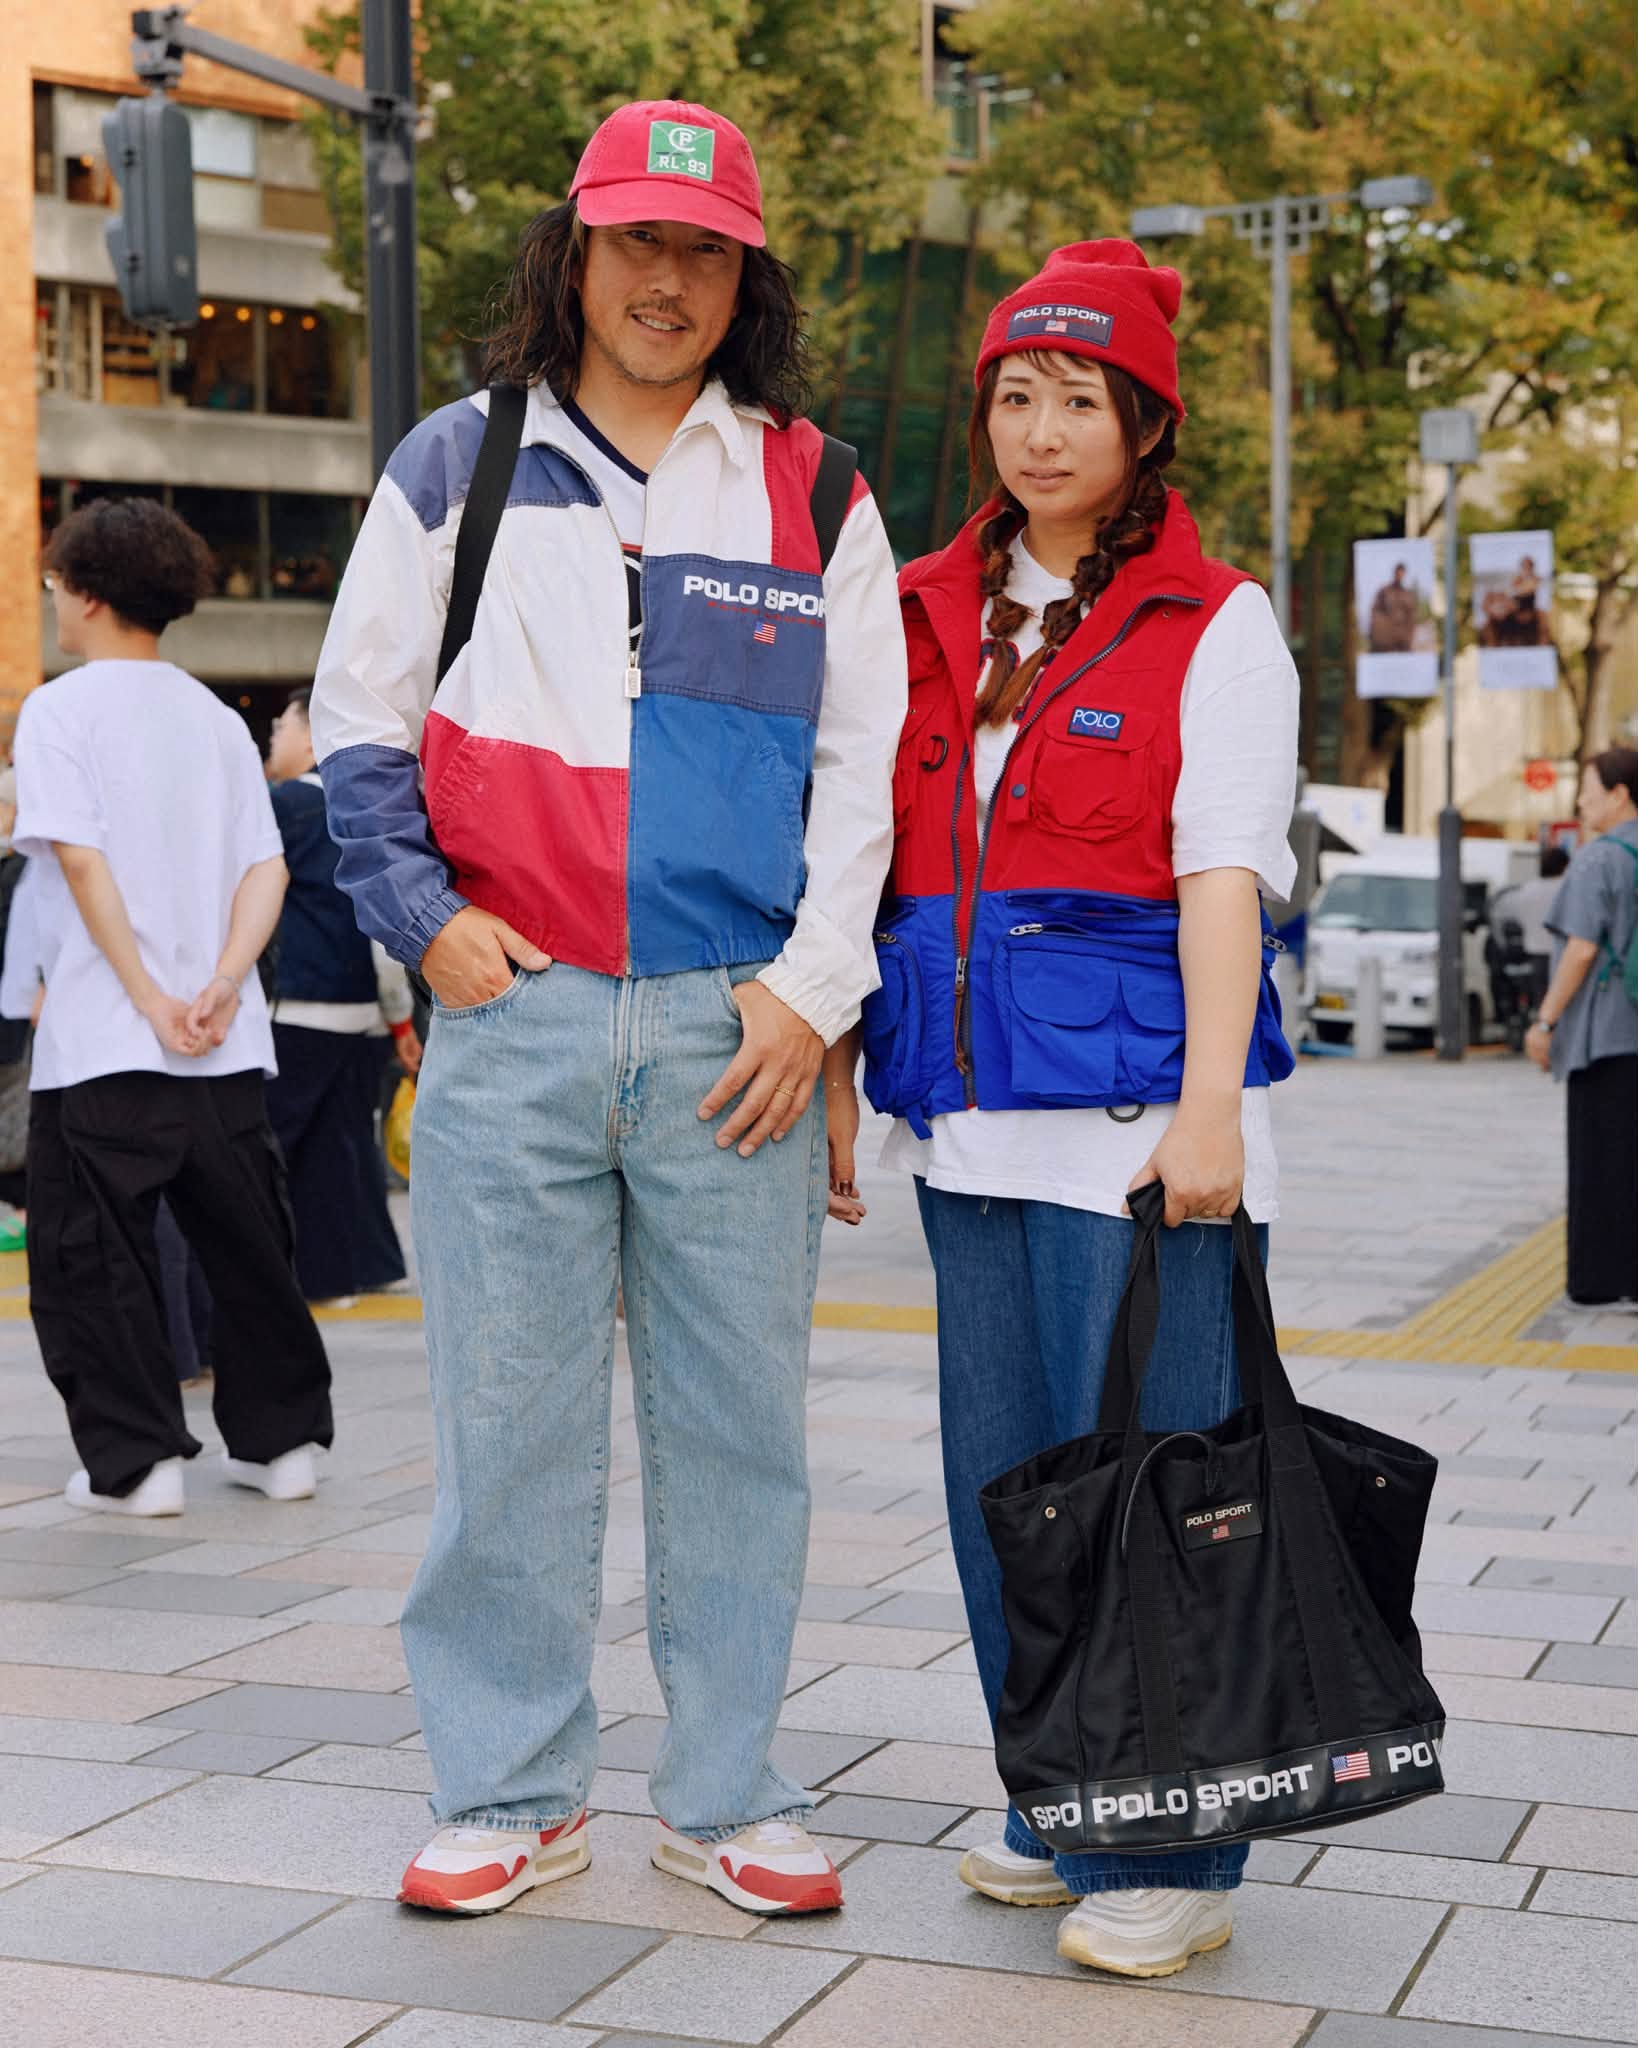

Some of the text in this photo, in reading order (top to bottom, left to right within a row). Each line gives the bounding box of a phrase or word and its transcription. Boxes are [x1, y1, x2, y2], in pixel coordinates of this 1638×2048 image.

[1012, 306, 1053, 321] POLO
[1055, 306, 1110, 325] SPORT
[683, 575, 759, 605] POLO
[1072, 708, 1121, 729] POLO
[1186, 1513, 1213, 1528] POLO
[1214, 1503, 1253, 1520] SPORT
[1091, 1788, 1189, 1824] POLO
[1196, 1764, 1313, 1810] SPORT
